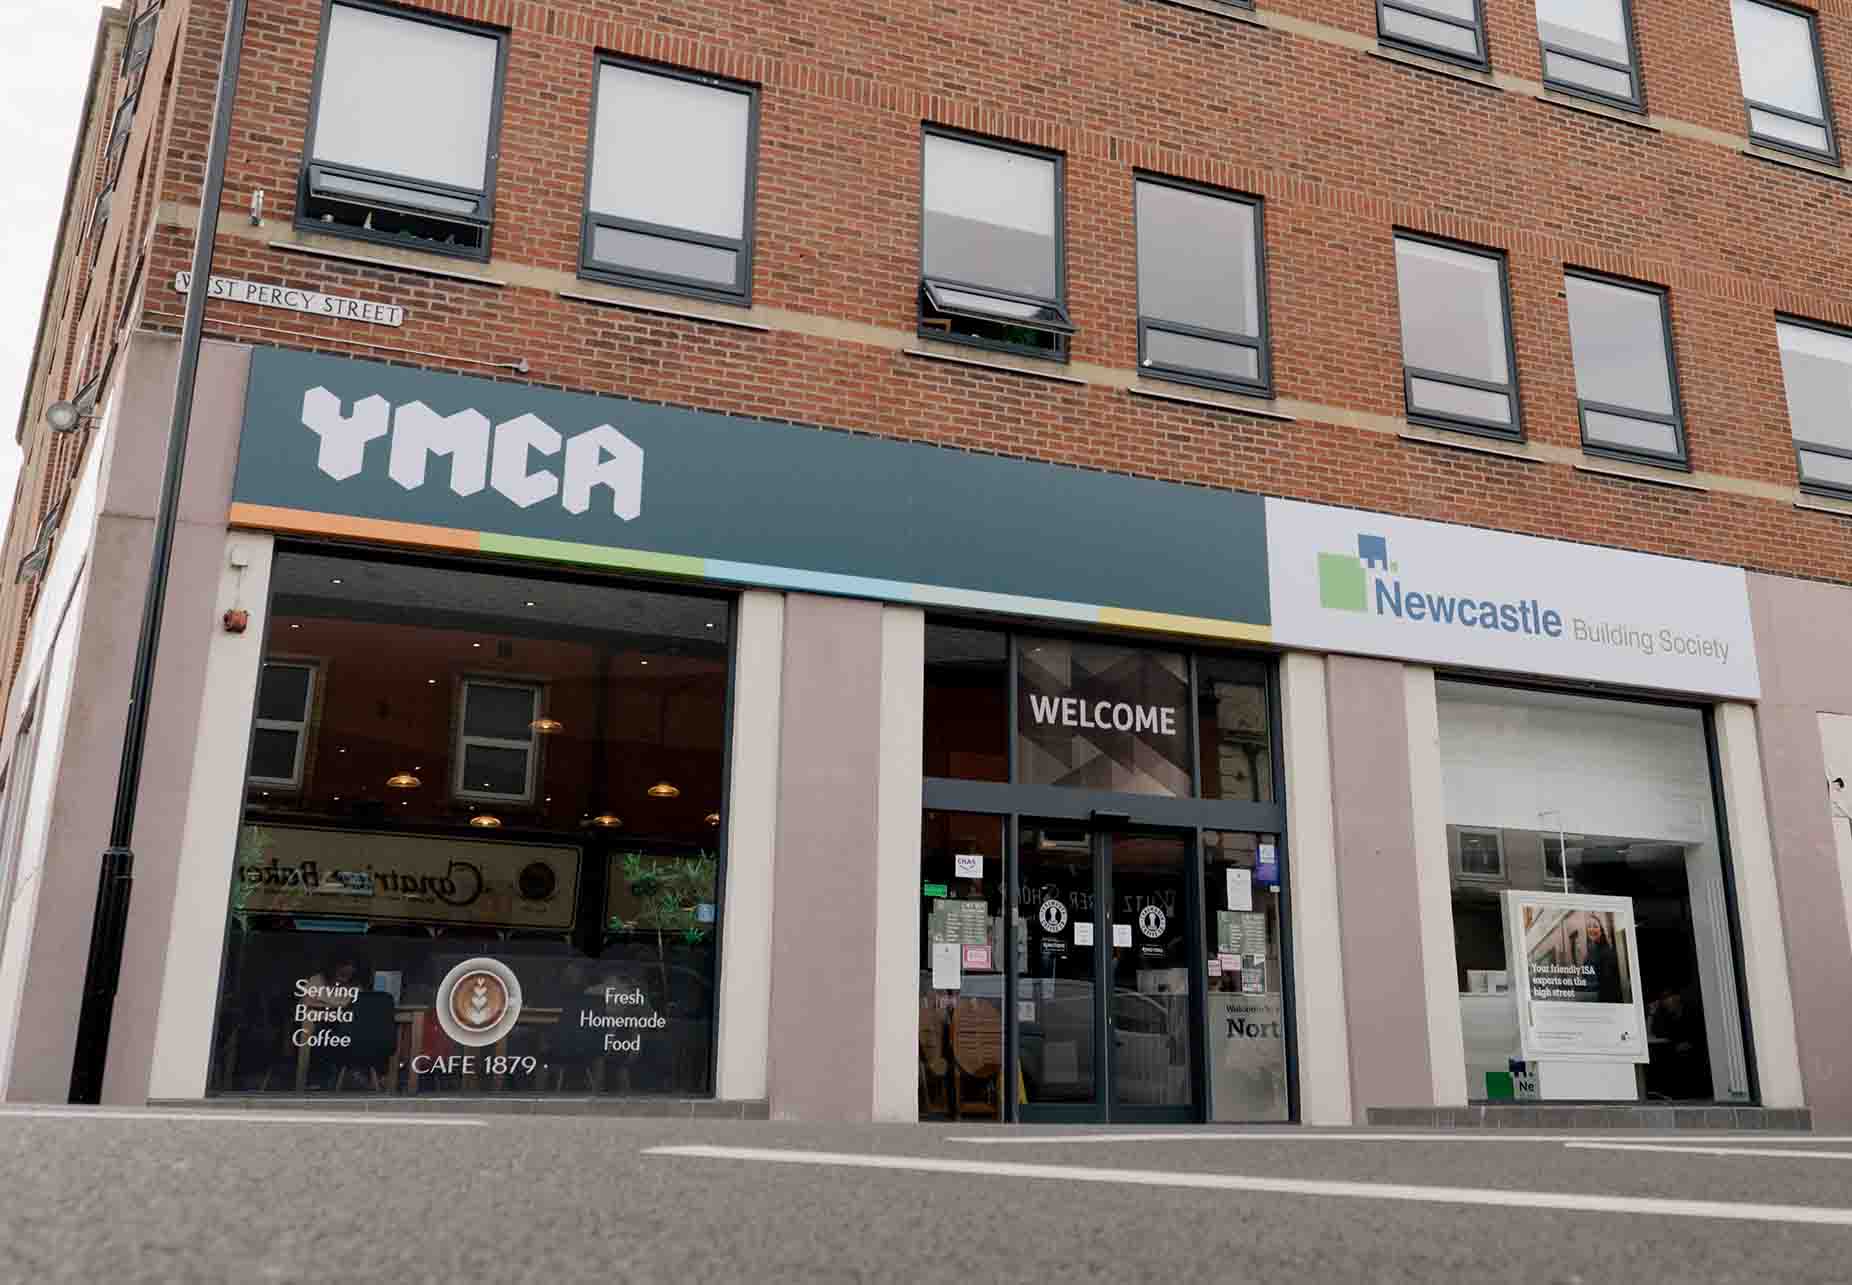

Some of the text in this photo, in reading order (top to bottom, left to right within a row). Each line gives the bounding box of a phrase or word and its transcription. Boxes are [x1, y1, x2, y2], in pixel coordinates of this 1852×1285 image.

[245, 283, 315, 309] PERCY
[323, 297, 402, 323] STREET
[302, 386, 644, 521] YMCA
[1375, 577, 1729, 664] Newcastle Building Society
[1029, 694, 1177, 735] WELCOME
[294, 979, 359, 1003] Serving
[605, 987, 644, 1006] Fresh
[295, 1003, 353, 1022] Barista
[580, 1009, 666, 1028] Homemade
[292, 1028, 351, 1047] Coffee
[604, 1033, 641, 1051] Food
[411, 1055, 537, 1074] CAFE 1879
